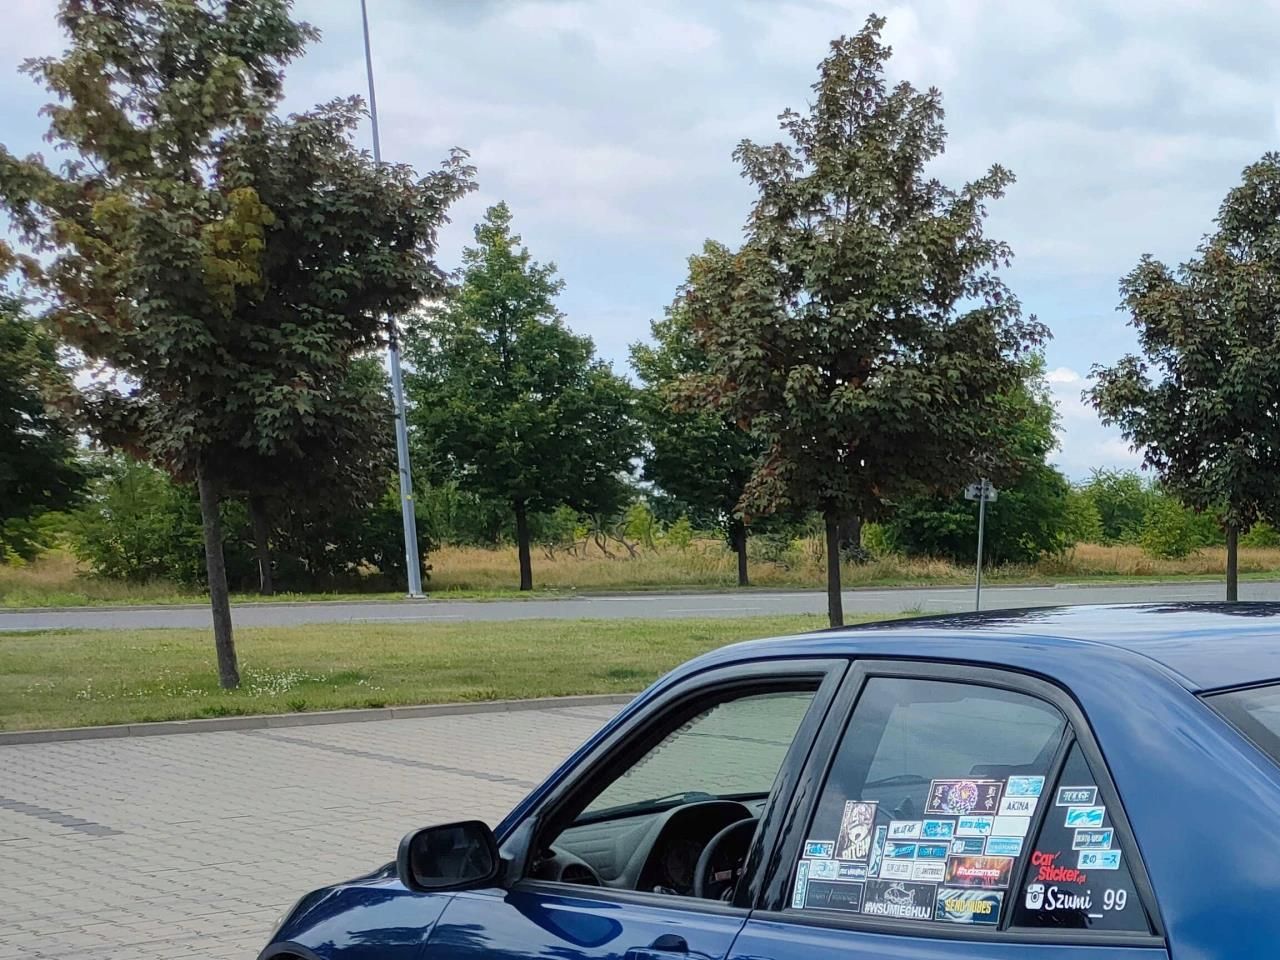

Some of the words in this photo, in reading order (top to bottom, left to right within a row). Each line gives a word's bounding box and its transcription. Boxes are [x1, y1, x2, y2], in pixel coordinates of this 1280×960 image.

[1006, 800, 1029, 811] AKINA
[1032, 851, 1054, 866] Car
[1038, 865, 1086, 884] Sticker.pl
